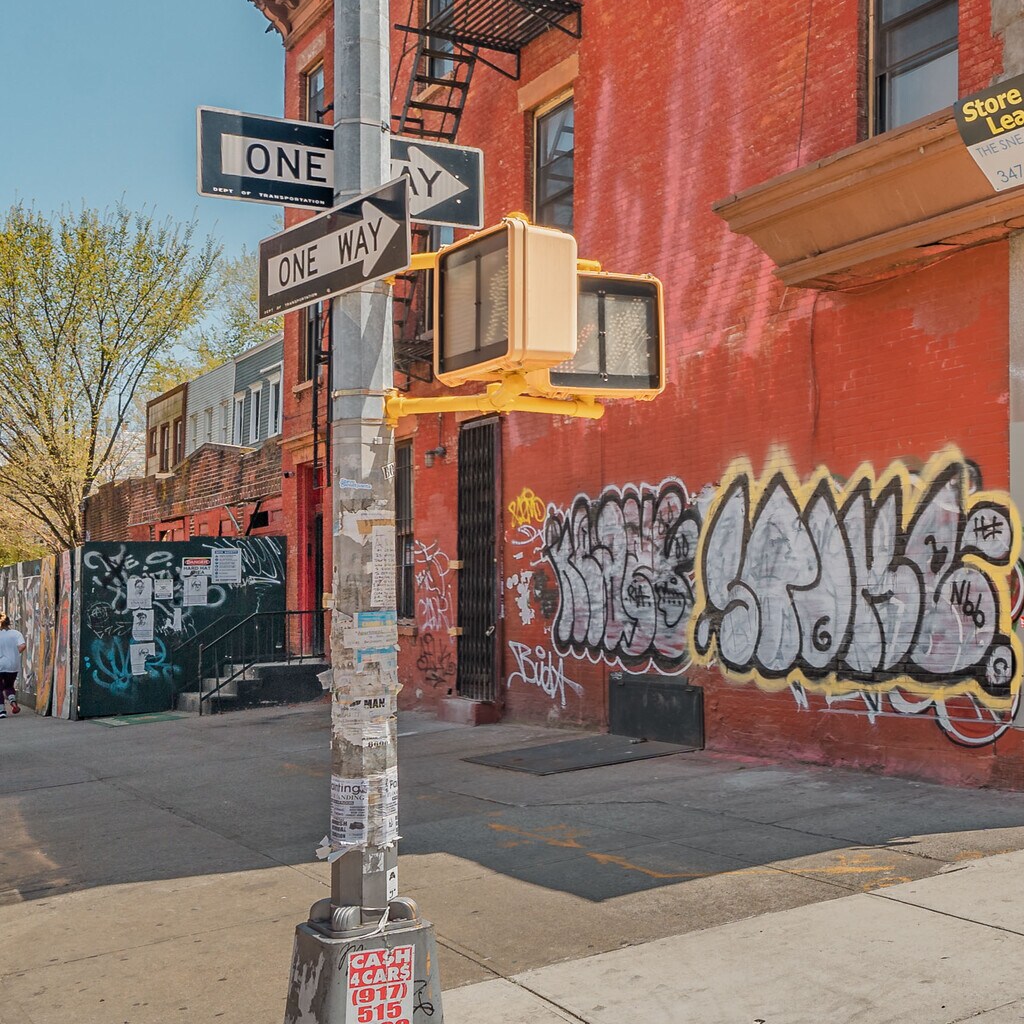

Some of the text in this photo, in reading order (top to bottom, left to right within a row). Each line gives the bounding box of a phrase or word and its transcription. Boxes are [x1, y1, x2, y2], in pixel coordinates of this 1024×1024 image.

[962, 88, 1022, 122] Store
[976, 141, 999, 158] THE
[246, 143, 441, 198] ONE AY
[258, 192, 326, 205] TRANSPORTATION
[279, 217, 383, 287] ONE WAY
[351, 972, 360, 986] 4
[352, 983, 407, 1006] (917)
[358, 1001, 402, 1023] 515
